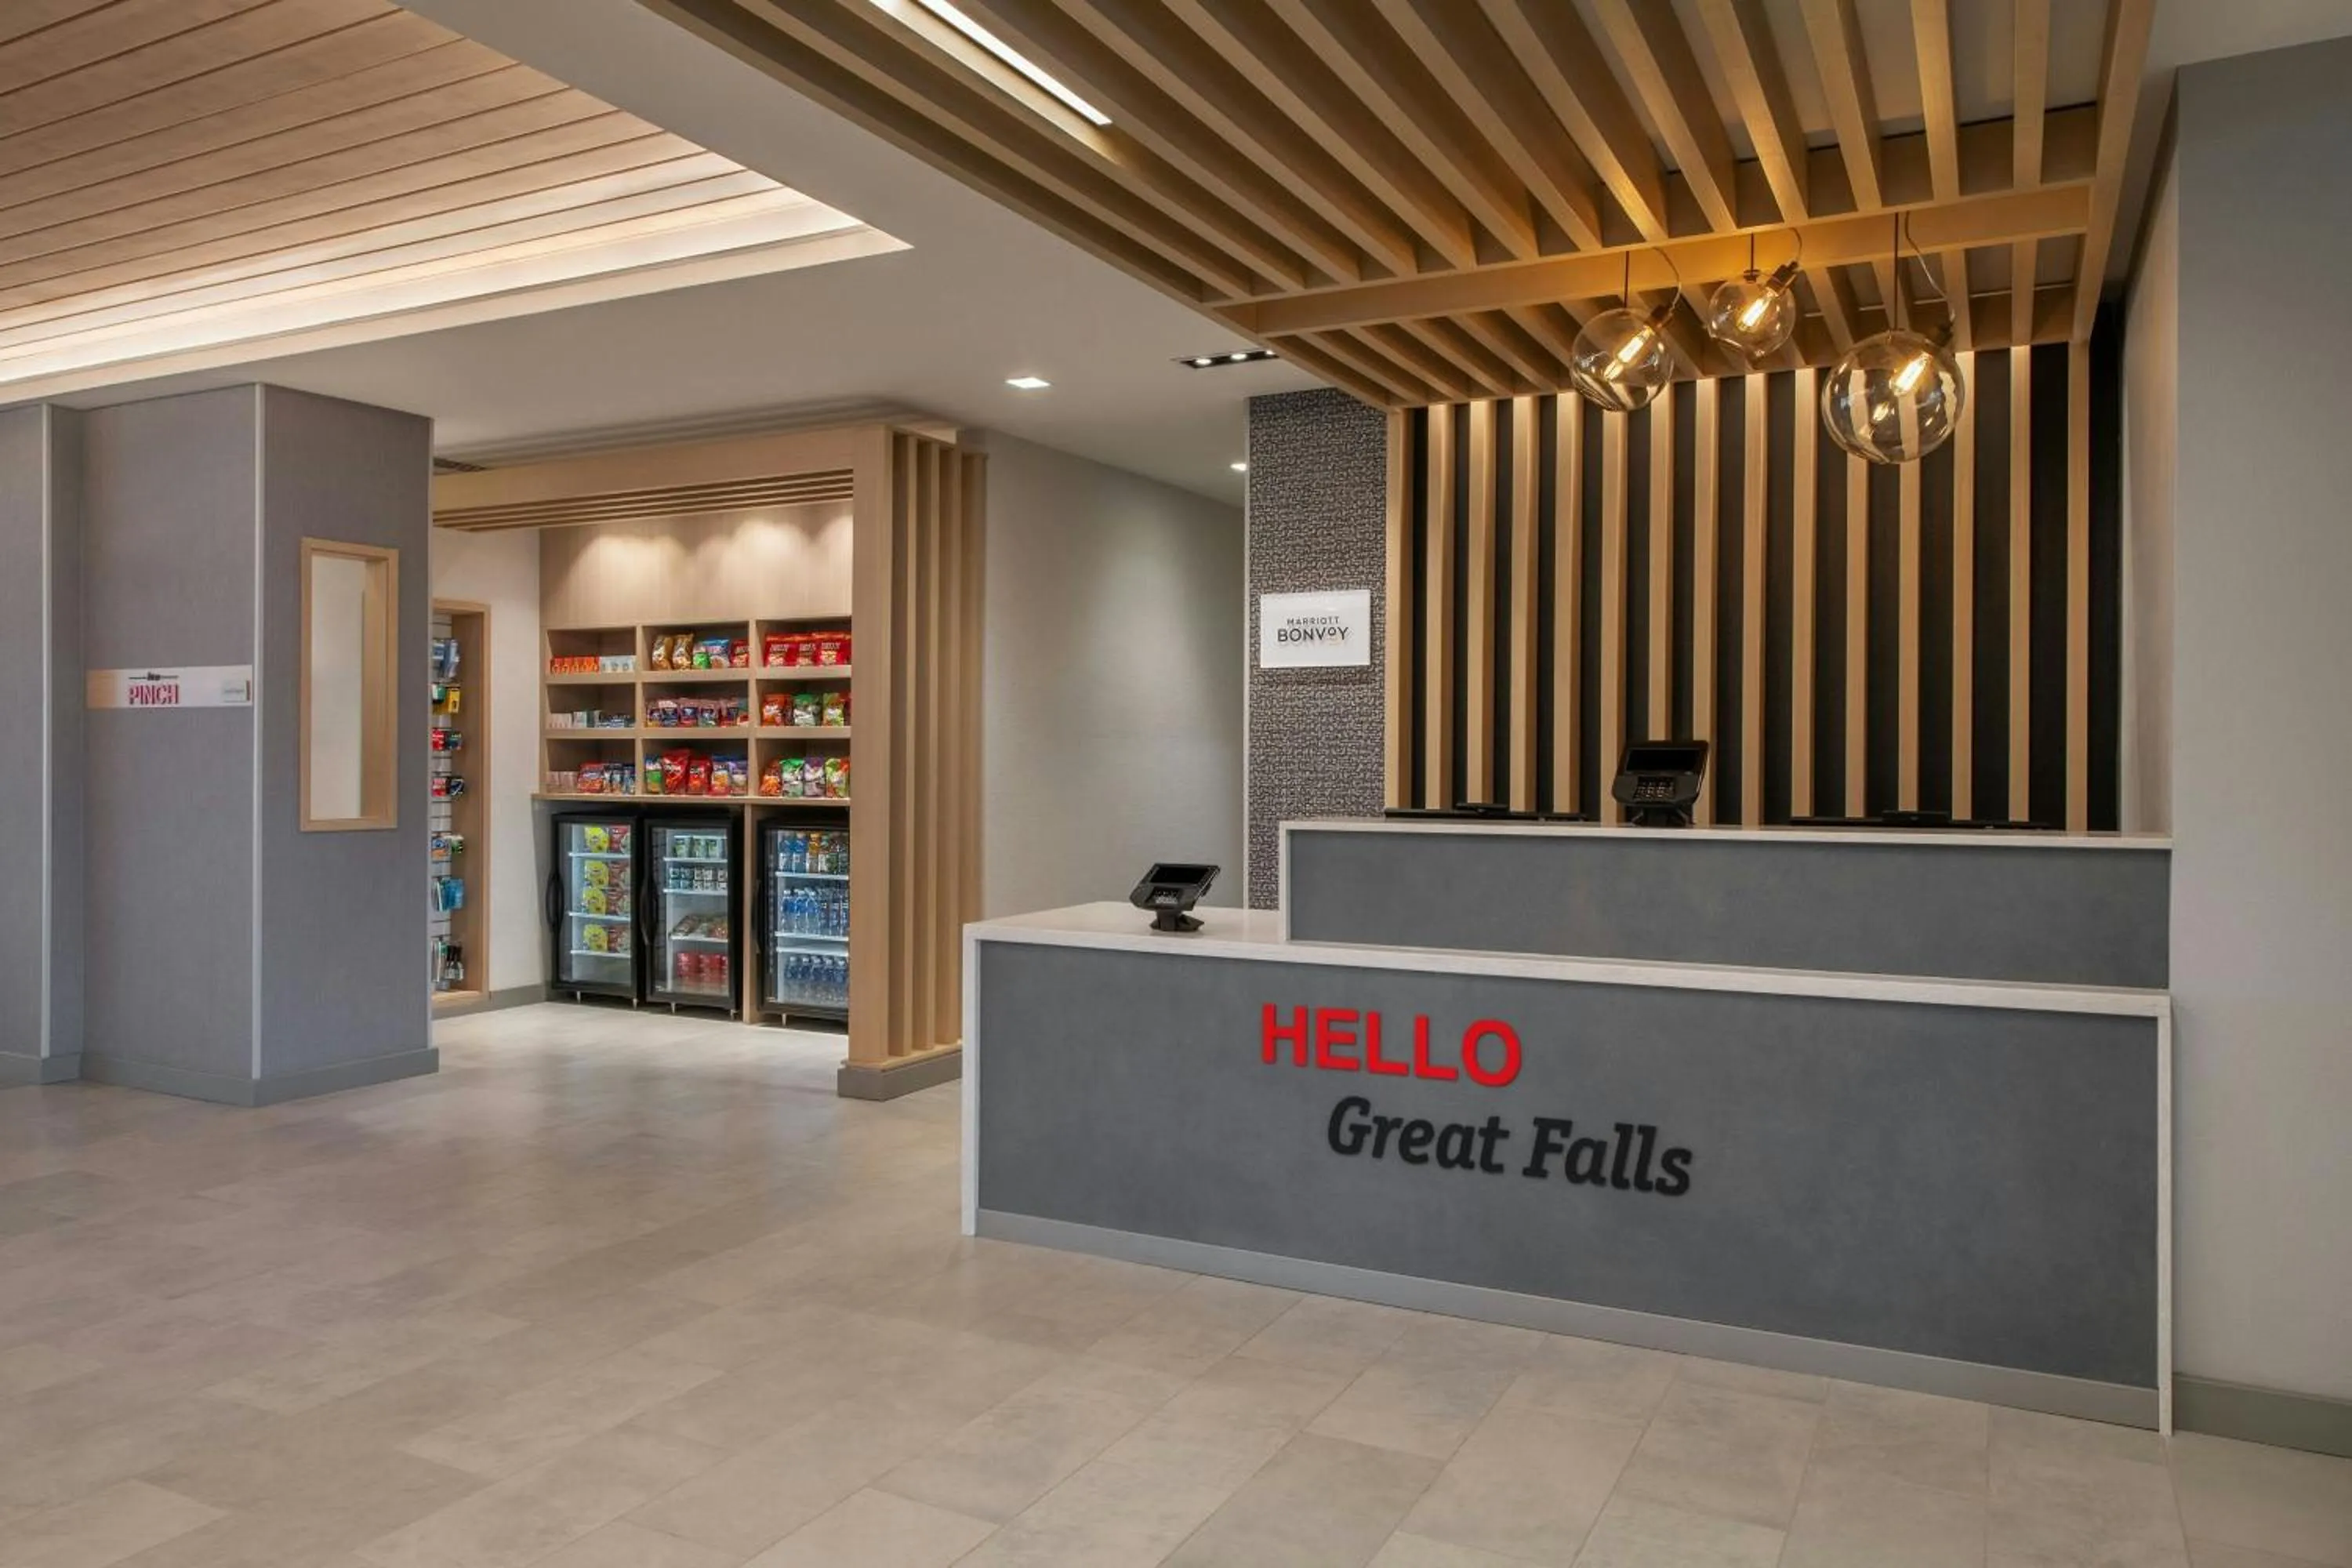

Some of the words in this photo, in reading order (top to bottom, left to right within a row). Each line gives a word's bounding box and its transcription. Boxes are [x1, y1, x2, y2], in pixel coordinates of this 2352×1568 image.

[1287, 615, 1340, 626] MARRIOTT
[1277, 626, 1349, 642] BONVOY
[129, 684, 180, 705] PINCH
[1261, 1003, 1523, 1087] HELLO
[1327, 1096, 1510, 1174] Great
[1522, 1116, 1693, 1196] Falls
